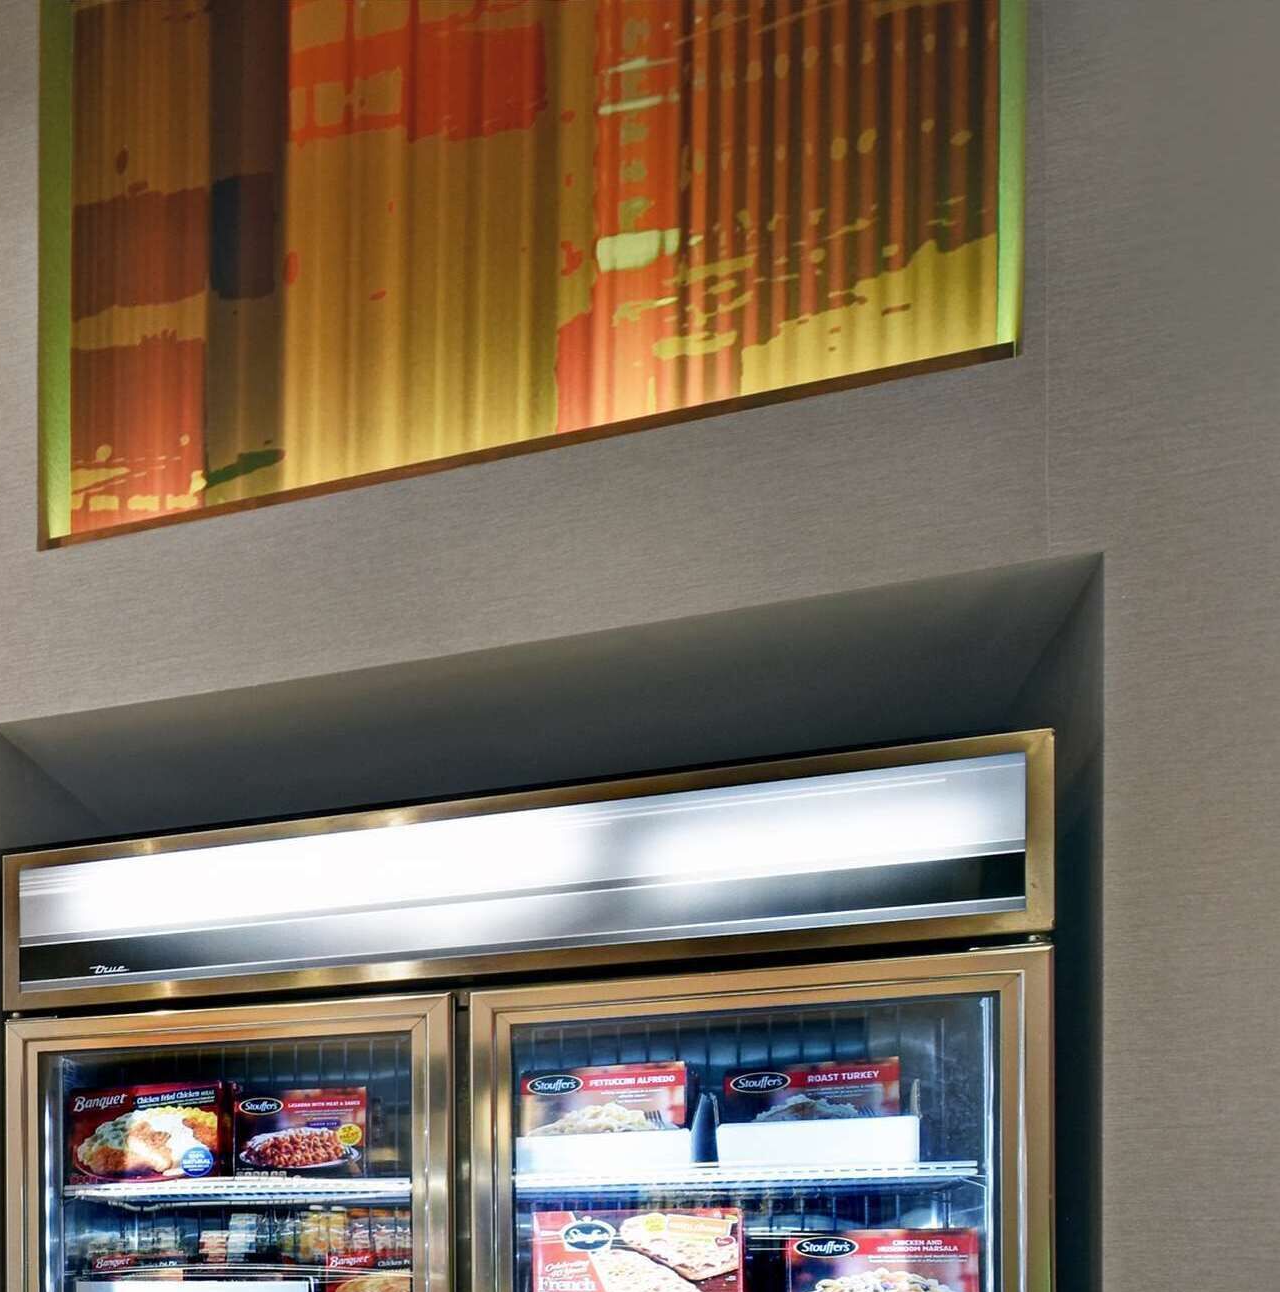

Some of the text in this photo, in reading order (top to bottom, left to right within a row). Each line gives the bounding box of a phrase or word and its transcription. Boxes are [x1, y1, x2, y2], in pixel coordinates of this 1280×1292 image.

[533, 1079, 577, 1093] Stouffer's
[637, 1075, 676, 1085] ALFREDO
[737, 1070, 880, 1090] Stouffer's ROAST TURKEY
[73, 1093, 128, 1112] Banquet
[244, 1100, 279, 1112] Stouffer's
[800, 1241, 851, 1255] Stouffer's
[330, 1255, 370, 1268] Banquet
